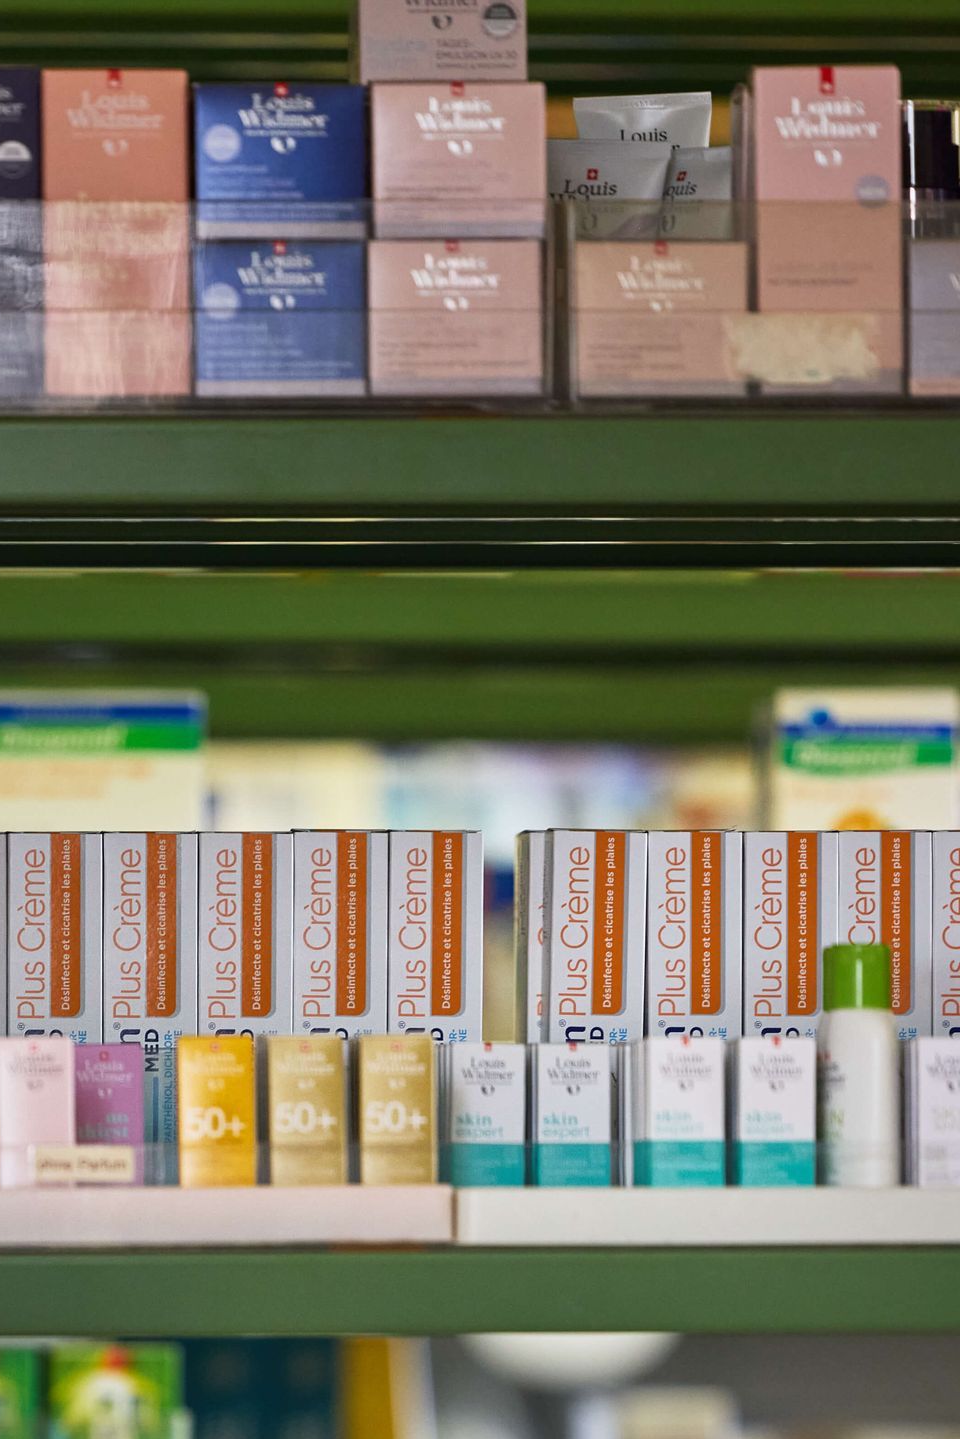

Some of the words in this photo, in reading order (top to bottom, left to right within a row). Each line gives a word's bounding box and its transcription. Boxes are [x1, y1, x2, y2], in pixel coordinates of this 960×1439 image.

[251, 93, 316, 111] Louis
[428, 95, 492, 113] Louis
[238, 110, 328, 128] Widmer
[415, 111, 507, 131] Widmer
[620, 128, 667, 142] Louis
[565, 180, 617, 197] Louis
[250, 251, 314, 269] Louis
[424, 253, 487, 270] Louis
[236, 267, 328, 286] Widmer
[410, 269, 501, 288] Widmer
[252, 840, 263, 871] plaies
[701, 838, 712, 868] plaies
[252, 875, 261, 889] les
[701, 872, 710, 886] les
[16, 849, 45, 951] Crème
[112, 849, 141, 951] Crème
[208, 849, 237, 951] Crème
[302, 848, 331, 950] Crème
[397, 848, 427, 950] Crème
[560, 846, 591, 949] Crème
[657, 846, 687, 949] Crème
[701, 890, 710, 934] cicatrise
[753, 847, 783, 950] Crème
[848, 847, 876, 947] Crème
[252, 892, 261, 936] cicatrise
[252, 941, 261, 951] et
[701, 938, 710, 948] et
[16, 961, 45, 1018] Plus
[112, 960, 141, 1018] Plus
[208, 960, 237, 1018] Plus
[252, 954, 261, 1011] Désinfecte
[302, 959, 331, 1017] Plus
[397, 959, 427, 1017] Plus
[558, 957, 588, 1015] Plus
[657, 958, 687, 1016] Plus
[701, 952, 710, 1008] Désinfecte
[753, 958, 783, 1016] Plus
[145, 1029, 159, 1072] MED
[471, 1056, 506, 1070] Louis
[556, 1056, 591, 1069] Louis
[461, 1068, 516, 1081] Widmer
[547, 1068, 600, 1082] Widmer
[186, 1107, 247, 1139] 50+
[275, 1102, 337, 1134] 50+
[365, 1101, 427, 1133] 50+
[455, 1113, 492, 1127] skin
[542, 1111, 578, 1125] skin
